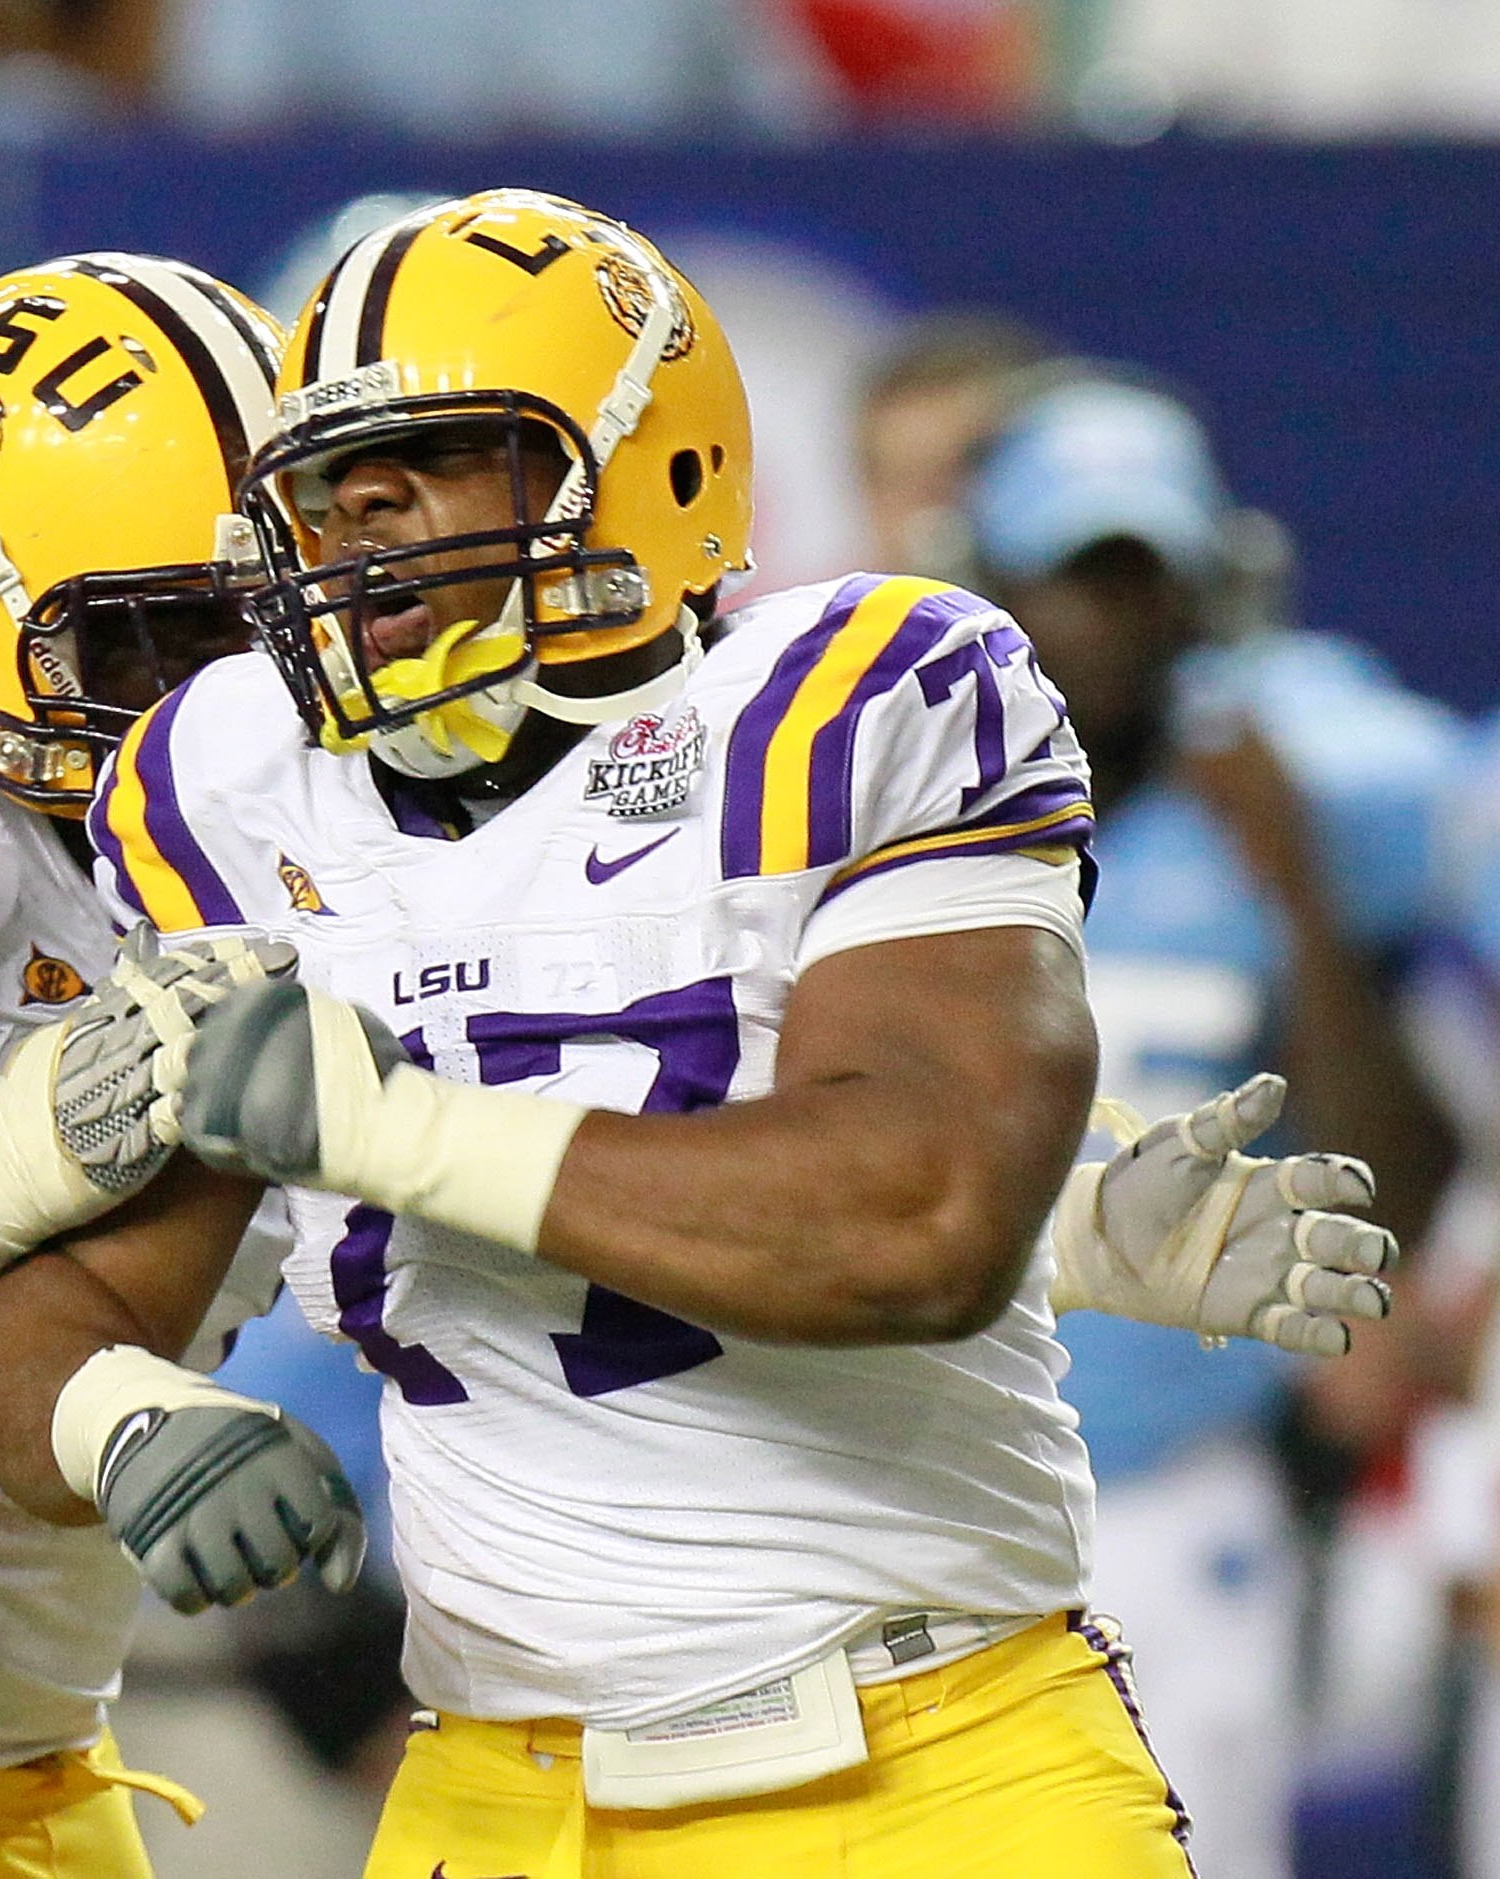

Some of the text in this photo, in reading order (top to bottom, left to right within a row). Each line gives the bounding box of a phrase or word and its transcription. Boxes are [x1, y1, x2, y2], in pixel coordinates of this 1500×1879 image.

[30, 642, 77, 697] ddell
[615, 775, 687, 806] GAME
[393, 958, 490, 1006] LSU
